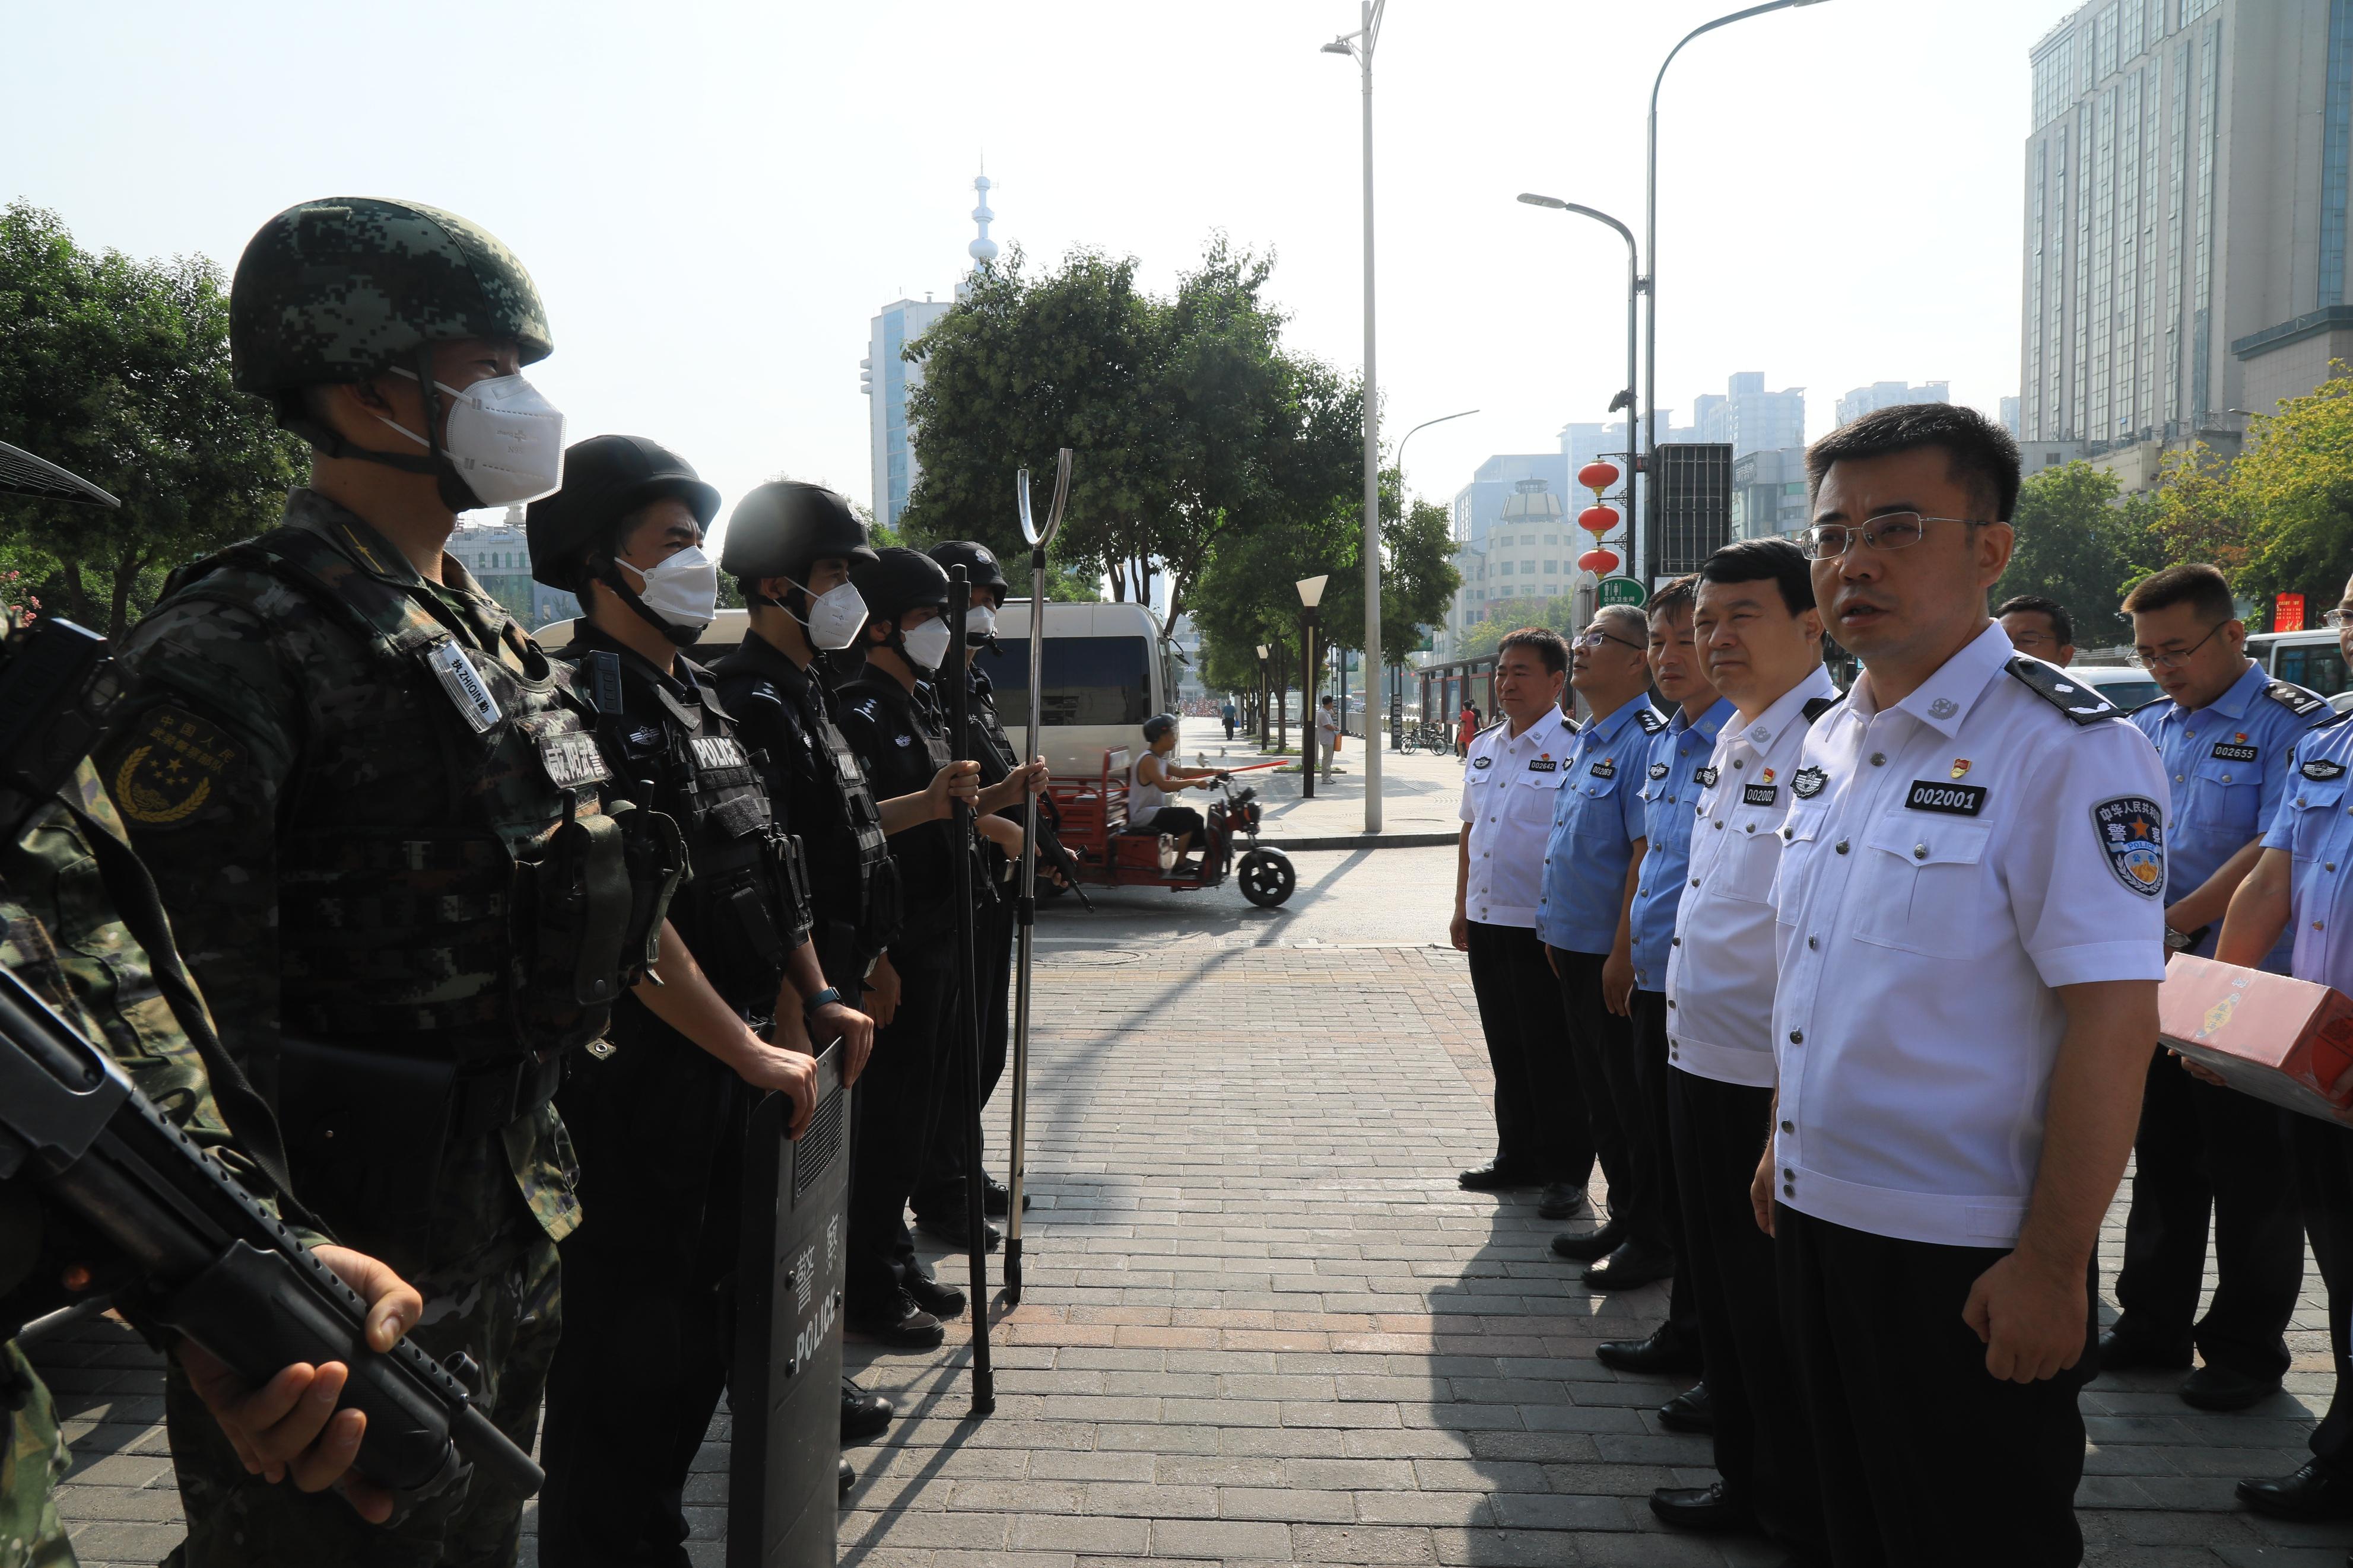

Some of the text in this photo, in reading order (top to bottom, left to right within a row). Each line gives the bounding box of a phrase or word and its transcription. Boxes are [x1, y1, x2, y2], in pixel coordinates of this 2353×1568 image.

[451, 659, 463, 673] 执
[458, 670, 483, 703] ZHIQIN
[150, 727, 224, 775] 武装警察部队
[161, 715, 235, 764] 中国人民
[691, 738, 742, 768] POLICE
[2215, 746, 2254, 759] 002655
[545, 735, 605, 782] 咸阳武警
[1747, 789, 1774, 802] 002002
[1913, 788, 1975, 809] 002001
[2099, 801, 2161, 826] 中华人民共和国
[2127, 842, 2157, 851] POLICE
[795, 1283, 836, 1375] POLICE
